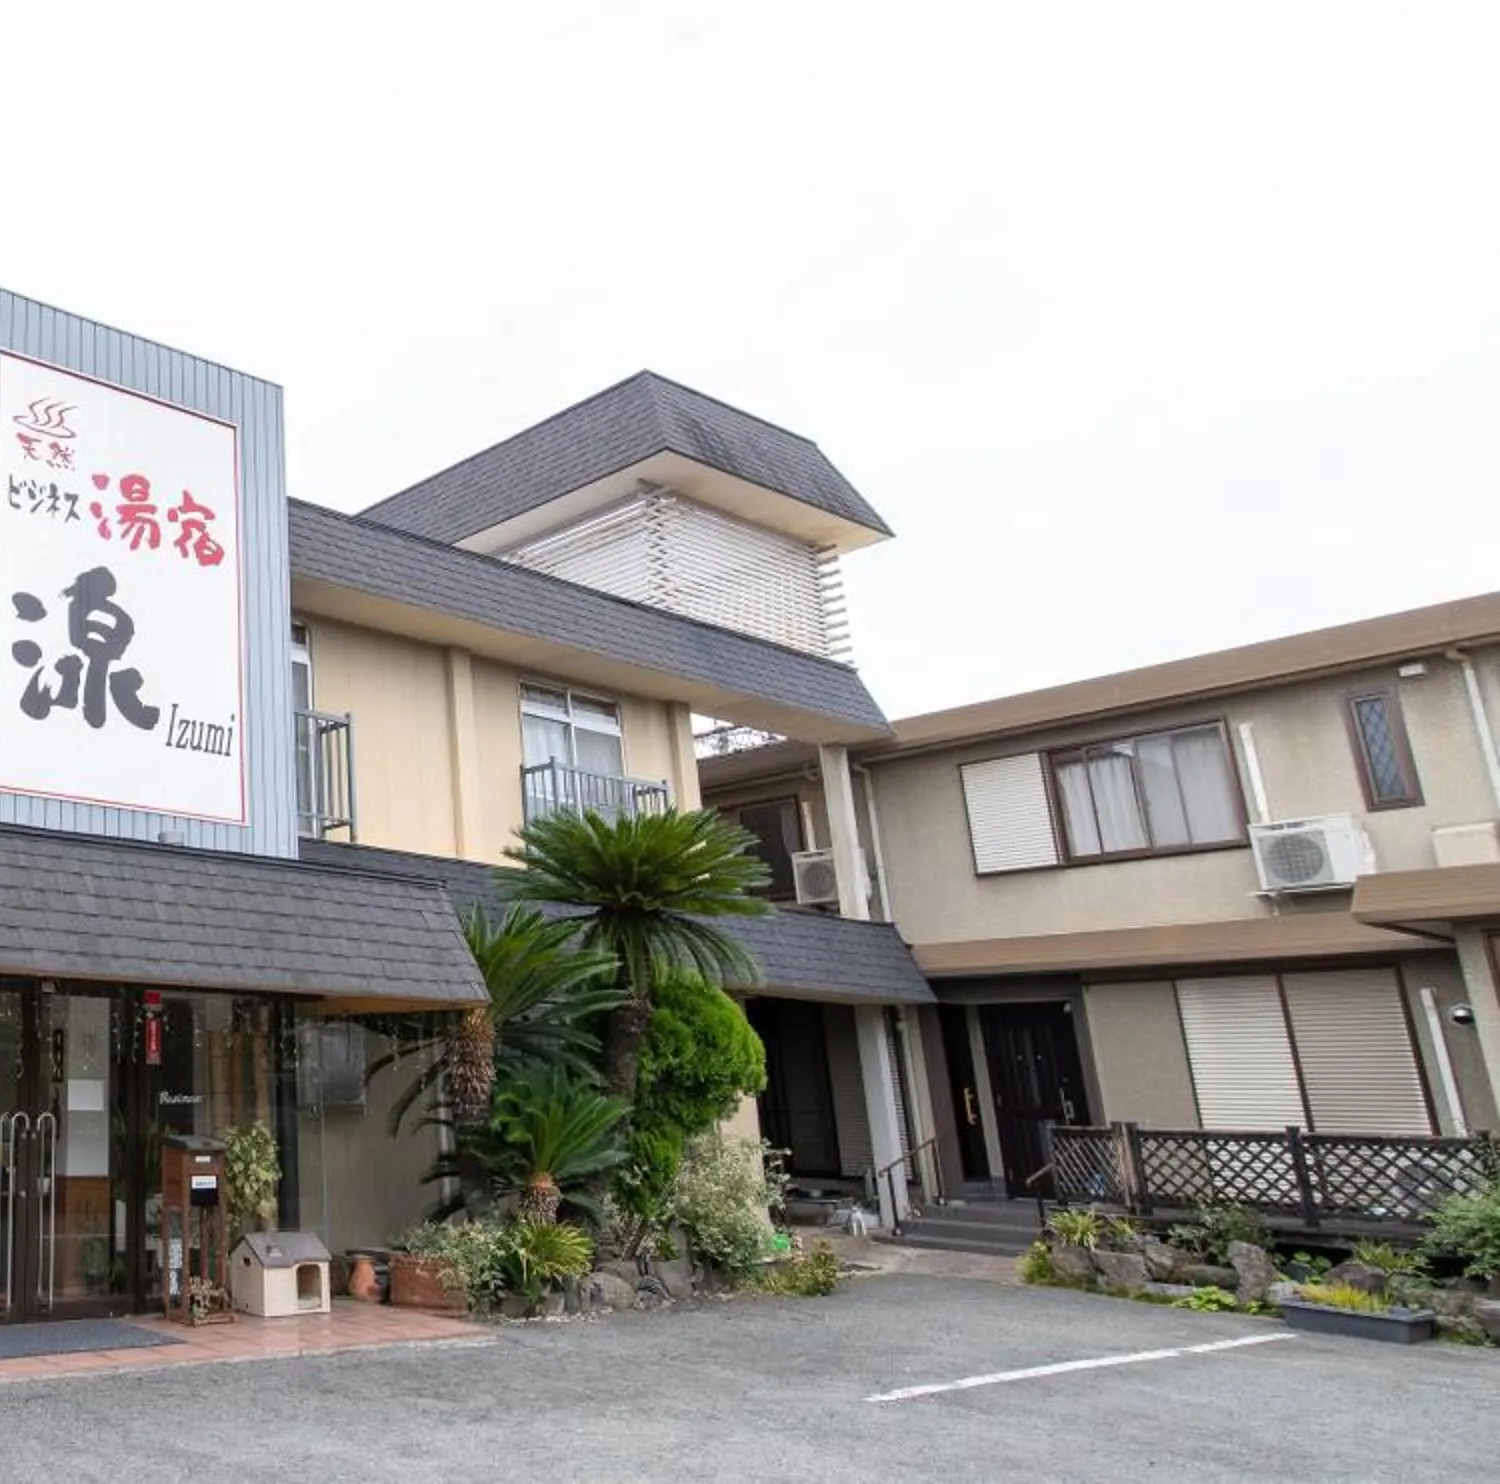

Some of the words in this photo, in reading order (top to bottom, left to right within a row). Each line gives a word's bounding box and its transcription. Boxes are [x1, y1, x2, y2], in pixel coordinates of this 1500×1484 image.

[16, 432, 76, 470] 天然
[8, 473, 80, 522] ビジネス
[90, 473, 225, 567] 湯宿
[165, 703, 235, 756] Izumi
